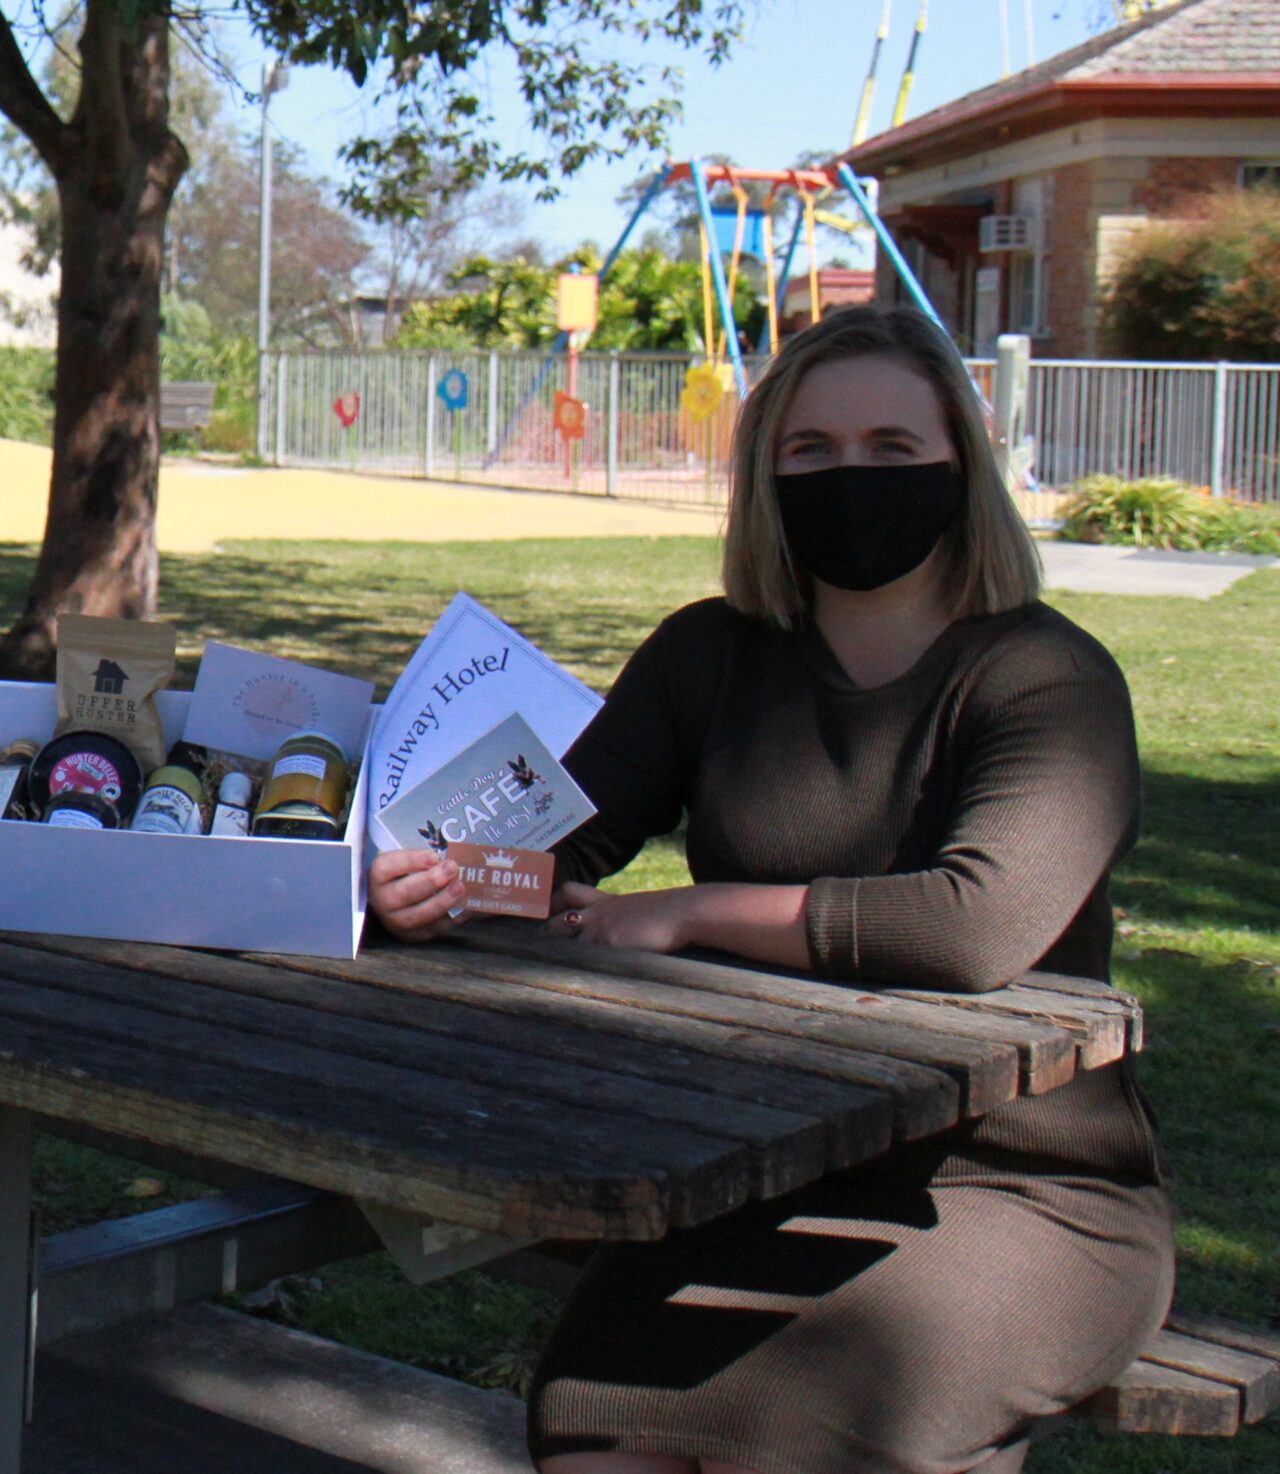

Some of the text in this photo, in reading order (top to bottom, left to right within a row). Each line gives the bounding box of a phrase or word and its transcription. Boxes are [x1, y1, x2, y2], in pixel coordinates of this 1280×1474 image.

[433, 647, 510, 705] Hotel
[77, 694, 136, 713] UPPER
[76, 708, 136, 723] HUNTER
[65, 753, 99, 767] HUNTER
[471, 771, 496, 792] Dog
[457, 866, 540, 889] THE ROYAL
